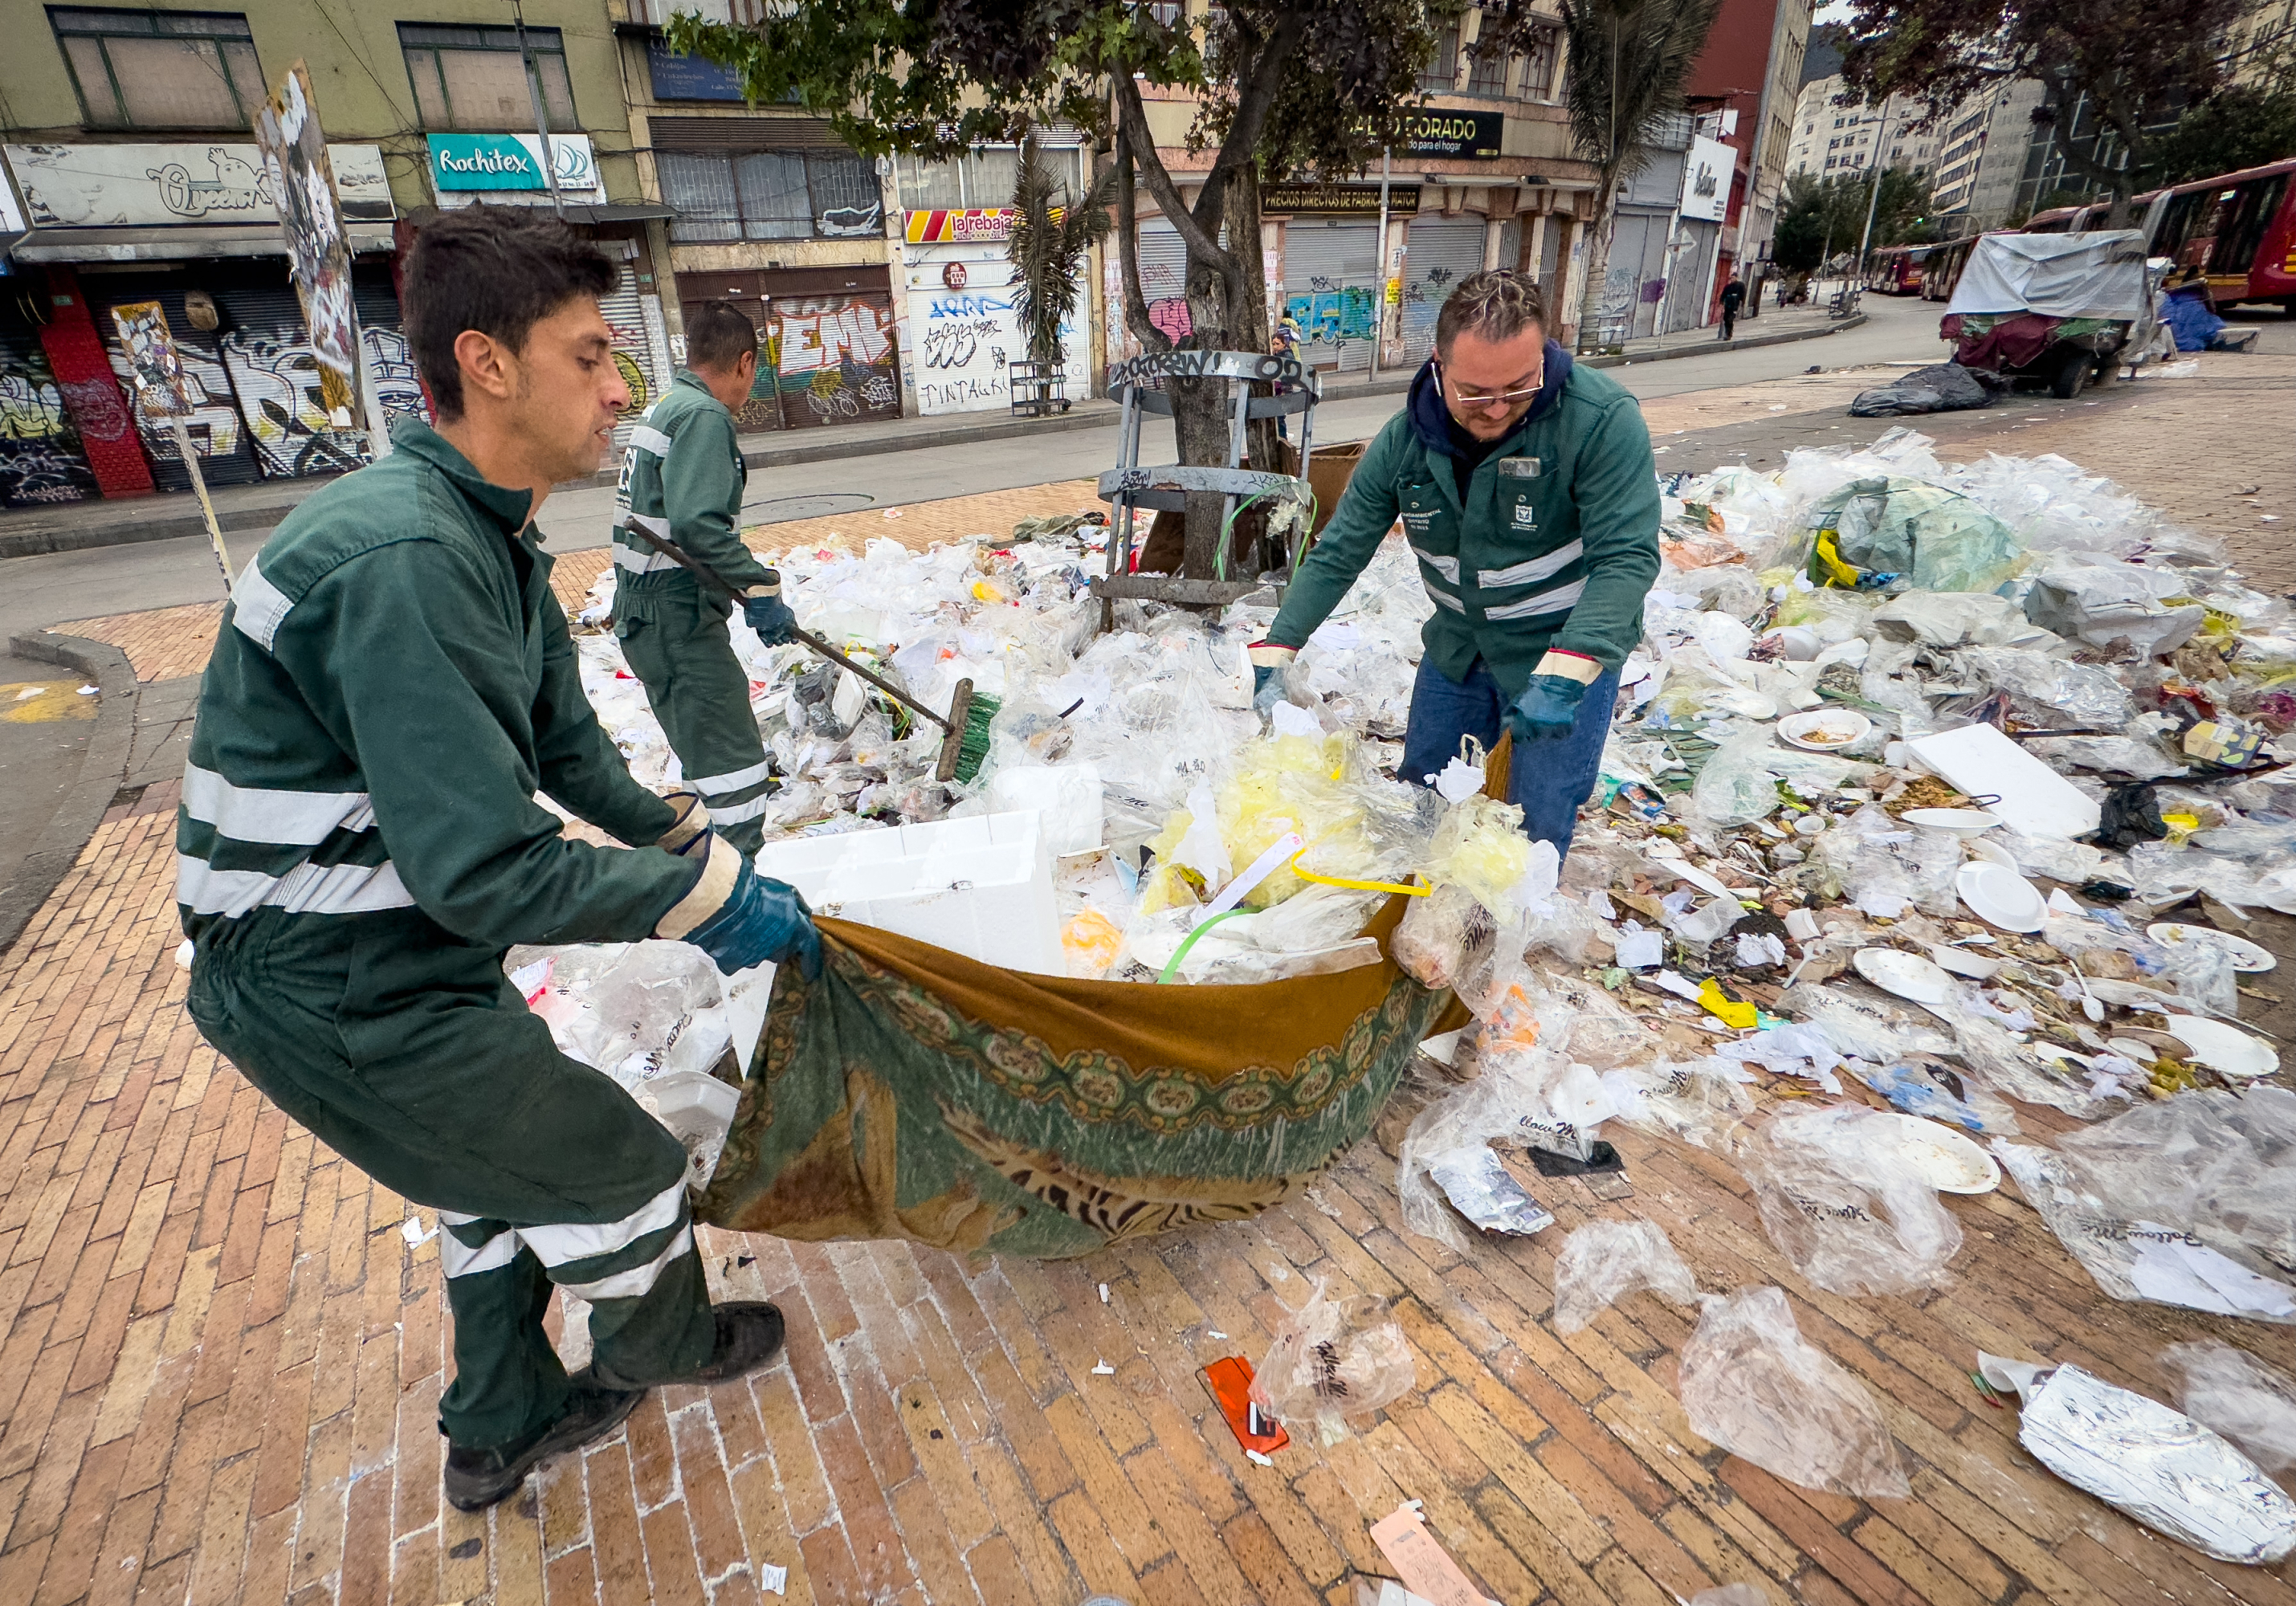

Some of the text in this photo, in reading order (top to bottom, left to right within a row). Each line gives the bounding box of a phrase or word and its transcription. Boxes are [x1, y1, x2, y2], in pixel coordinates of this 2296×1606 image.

[1418, 141, 1433, 151] para
[1434, 140, 1442, 150] el
[1442, 141, 1462, 153] hogar
[439, 147, 531, 174] Rochitex
[1266, 191, 1417, 207] PRECIOS DIRECTOS DE FABRICA MAYOR
[952, 214, 1013, 236] la rebaja
